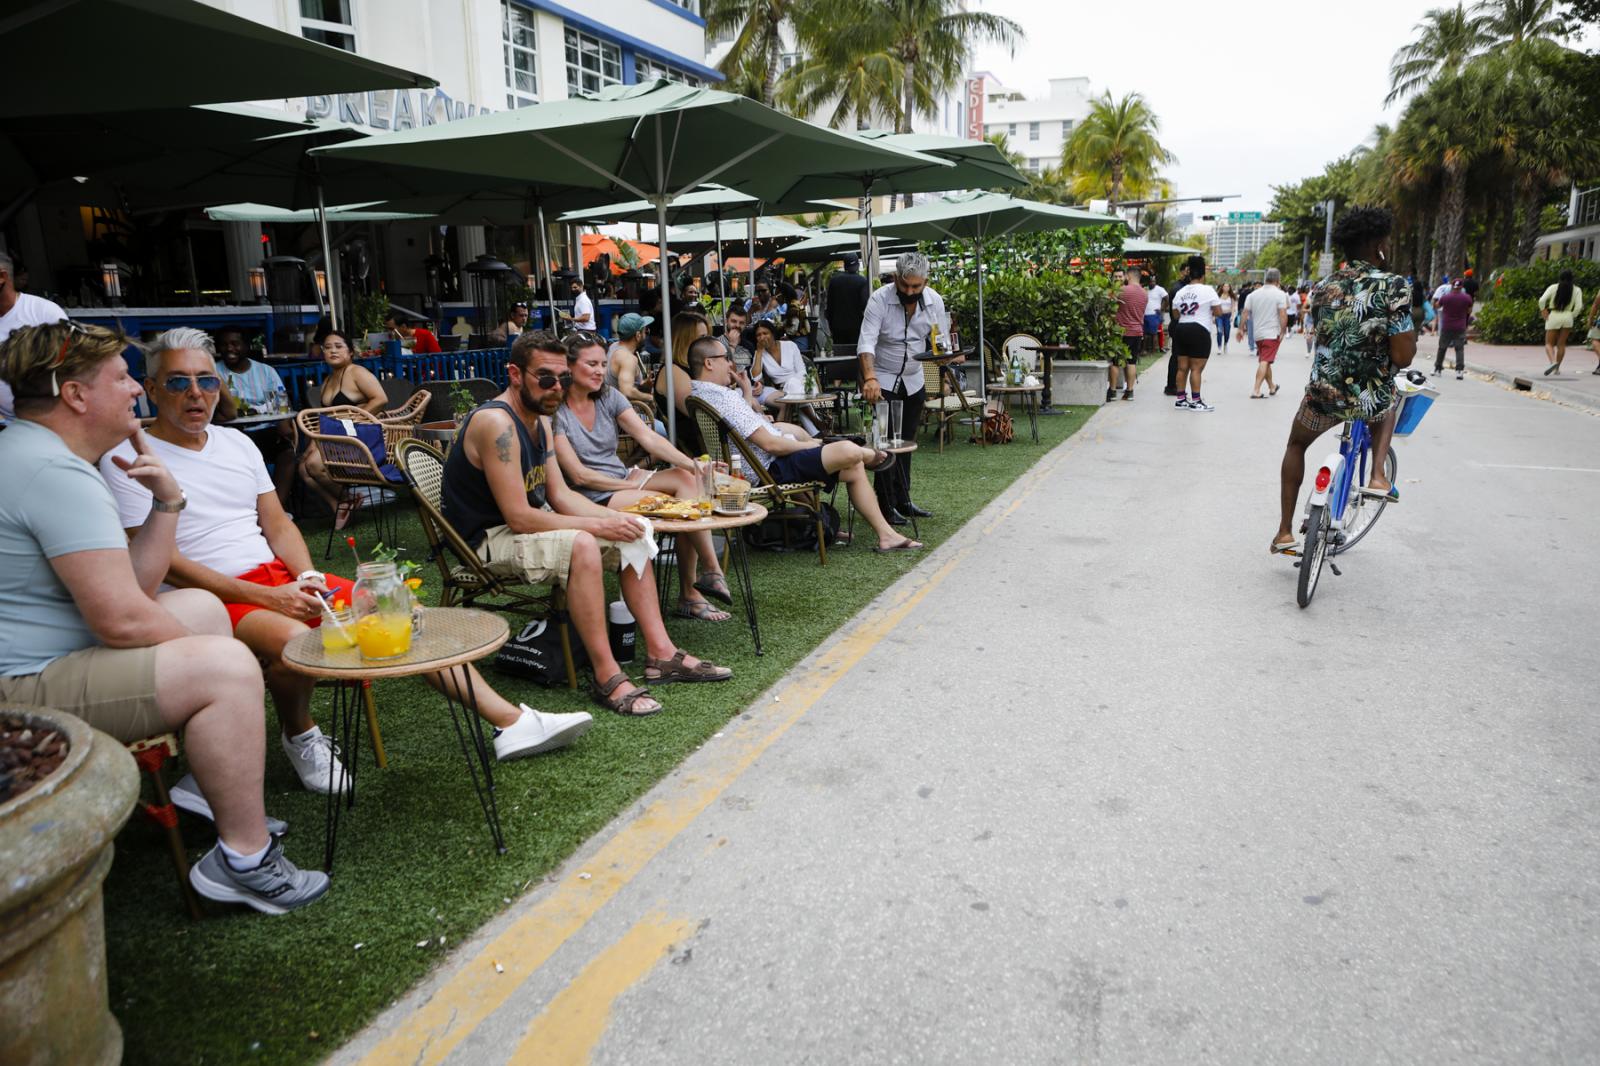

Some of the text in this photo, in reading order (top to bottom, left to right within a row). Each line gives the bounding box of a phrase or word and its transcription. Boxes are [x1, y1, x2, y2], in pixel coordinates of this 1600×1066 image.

[306, 89, 498, 131] BREAKW
[969, 79, 980, 138] EDIS
[1180, 302, 1200, 316] 22
